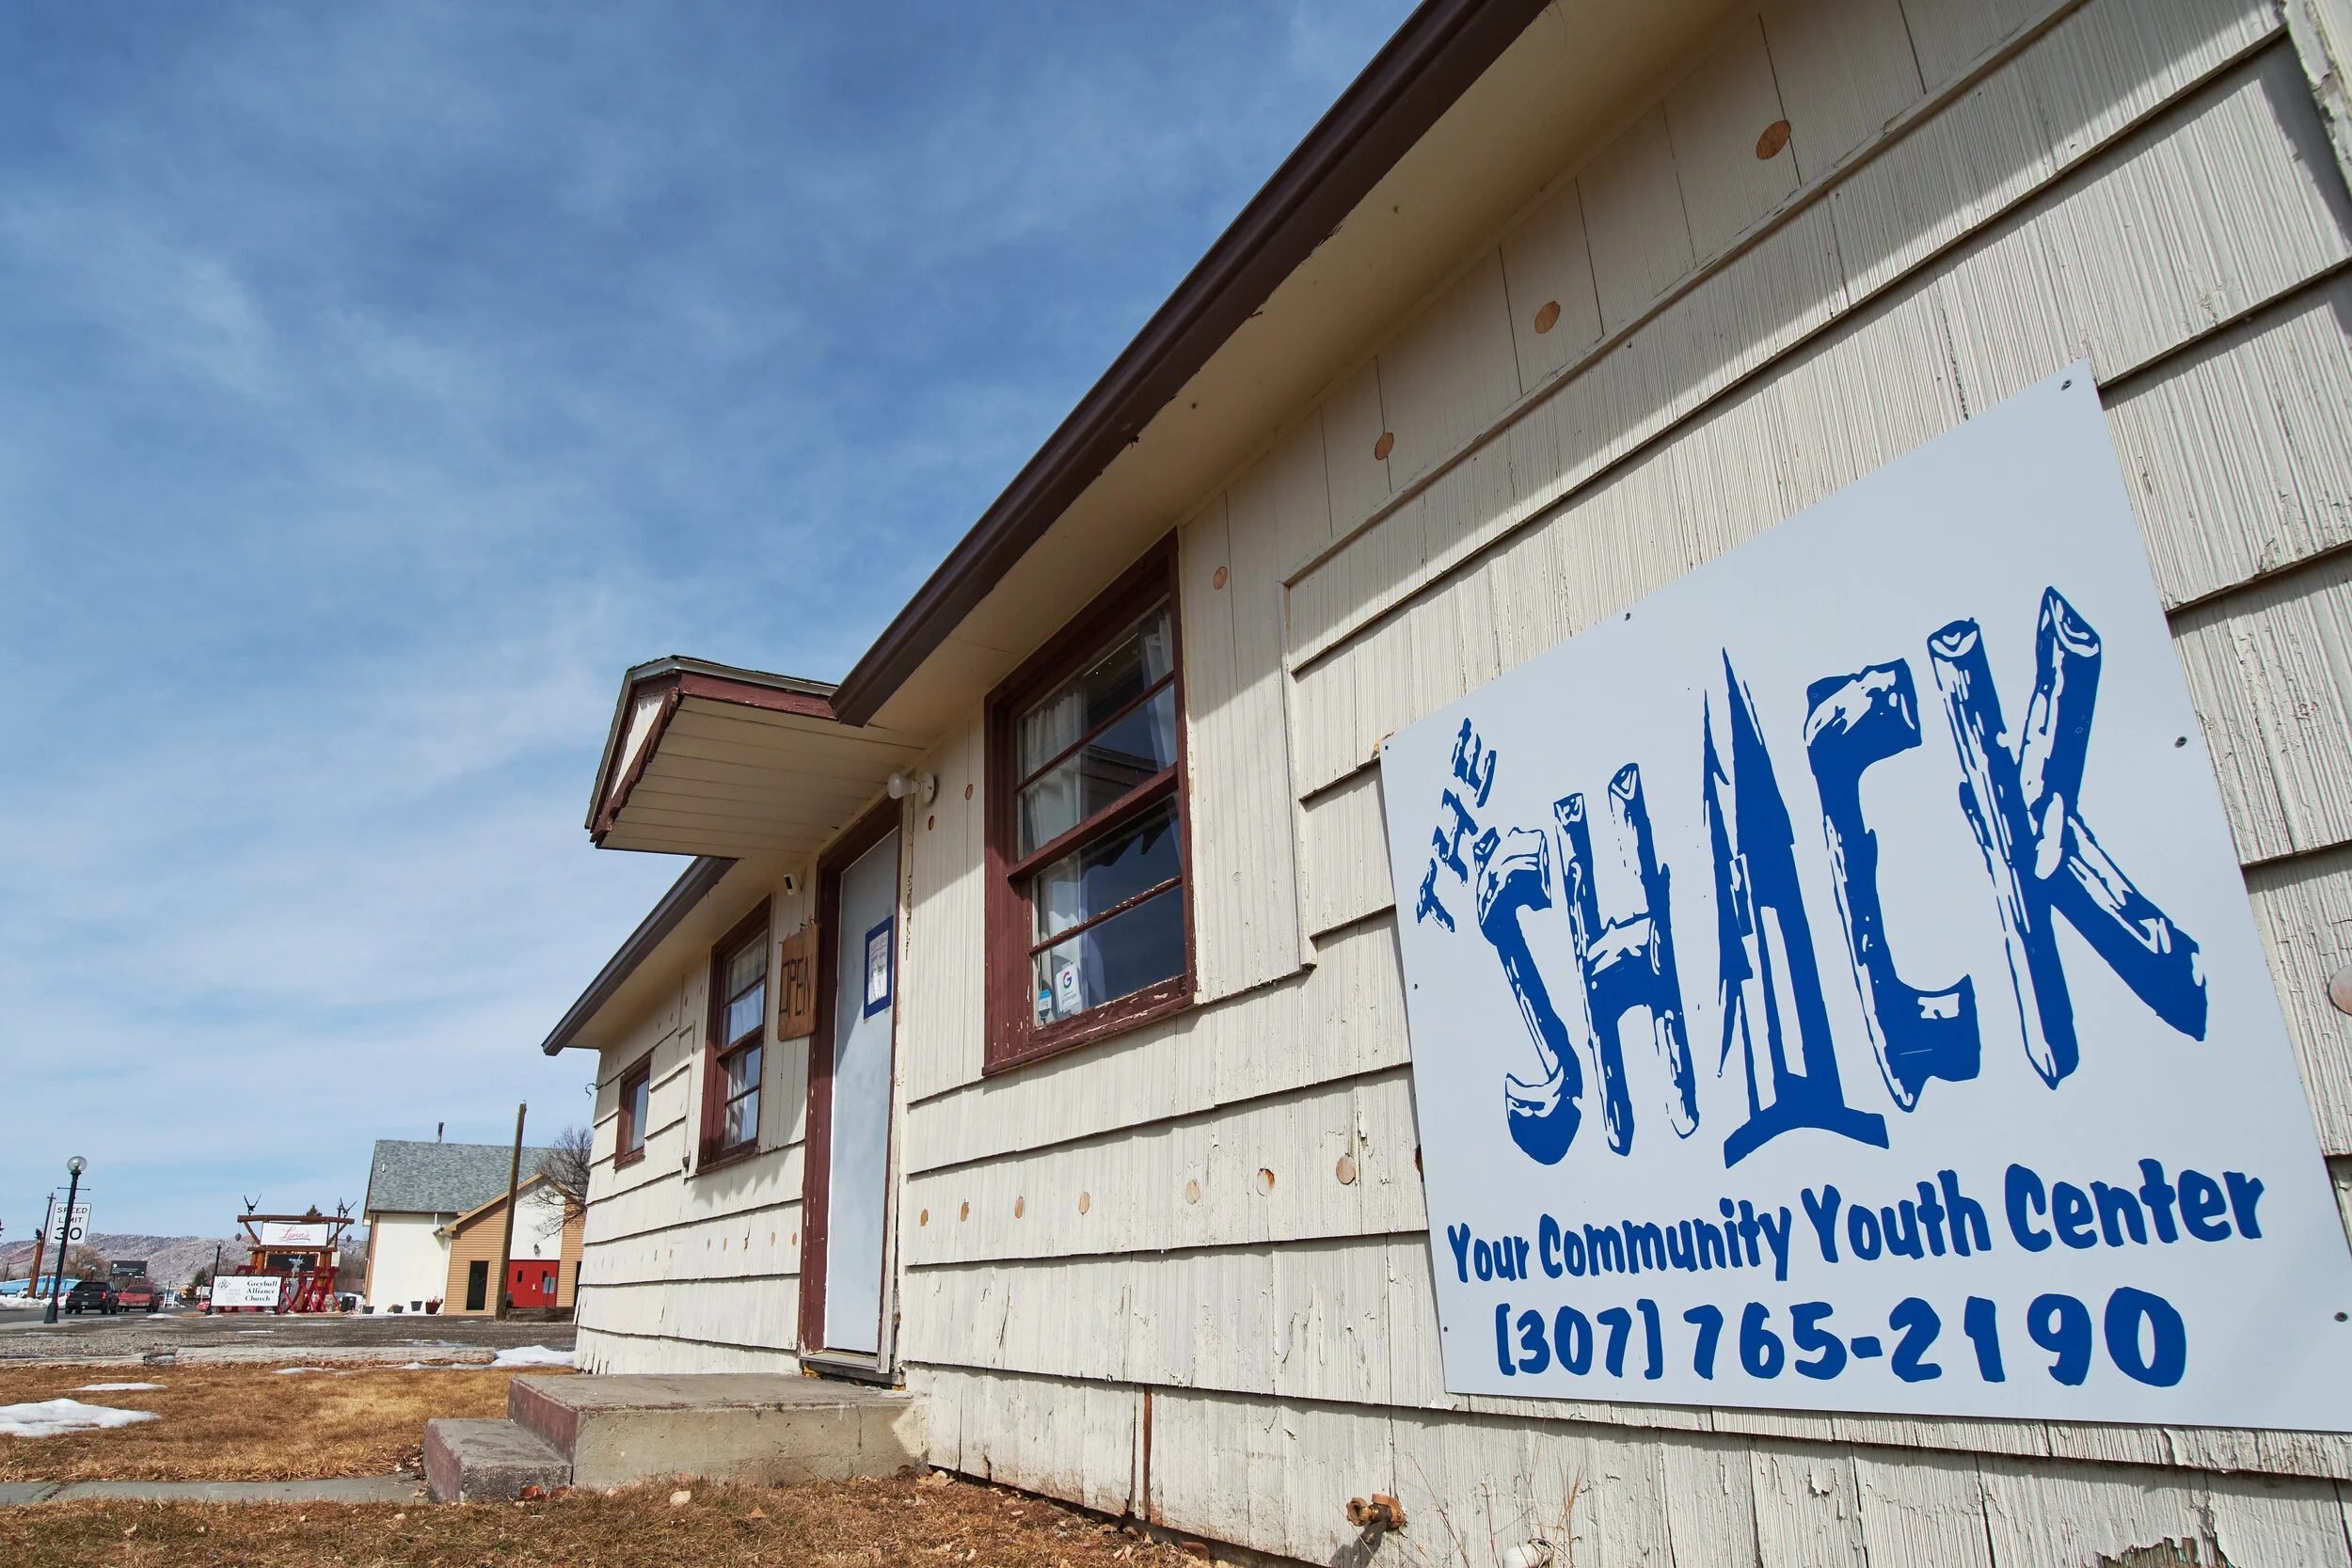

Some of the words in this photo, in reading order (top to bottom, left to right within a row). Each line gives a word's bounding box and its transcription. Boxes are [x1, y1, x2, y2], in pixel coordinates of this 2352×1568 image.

[1415, 717, 1498, 933] THE
[1476, 585, 2209, 1169] SHACK
[779, 955, 815, 1019] OPEN
[55, 1227, 82, 1240] 30
[1447, 1222, 1531, 1284] Your
[1538, 1196, 1792, 1282] Community
[1800, 1169, 1993, 1264] Youth
[2005, 1158, 2265, 1253] Center
[246, 1280, 278, 1290] Greybull
